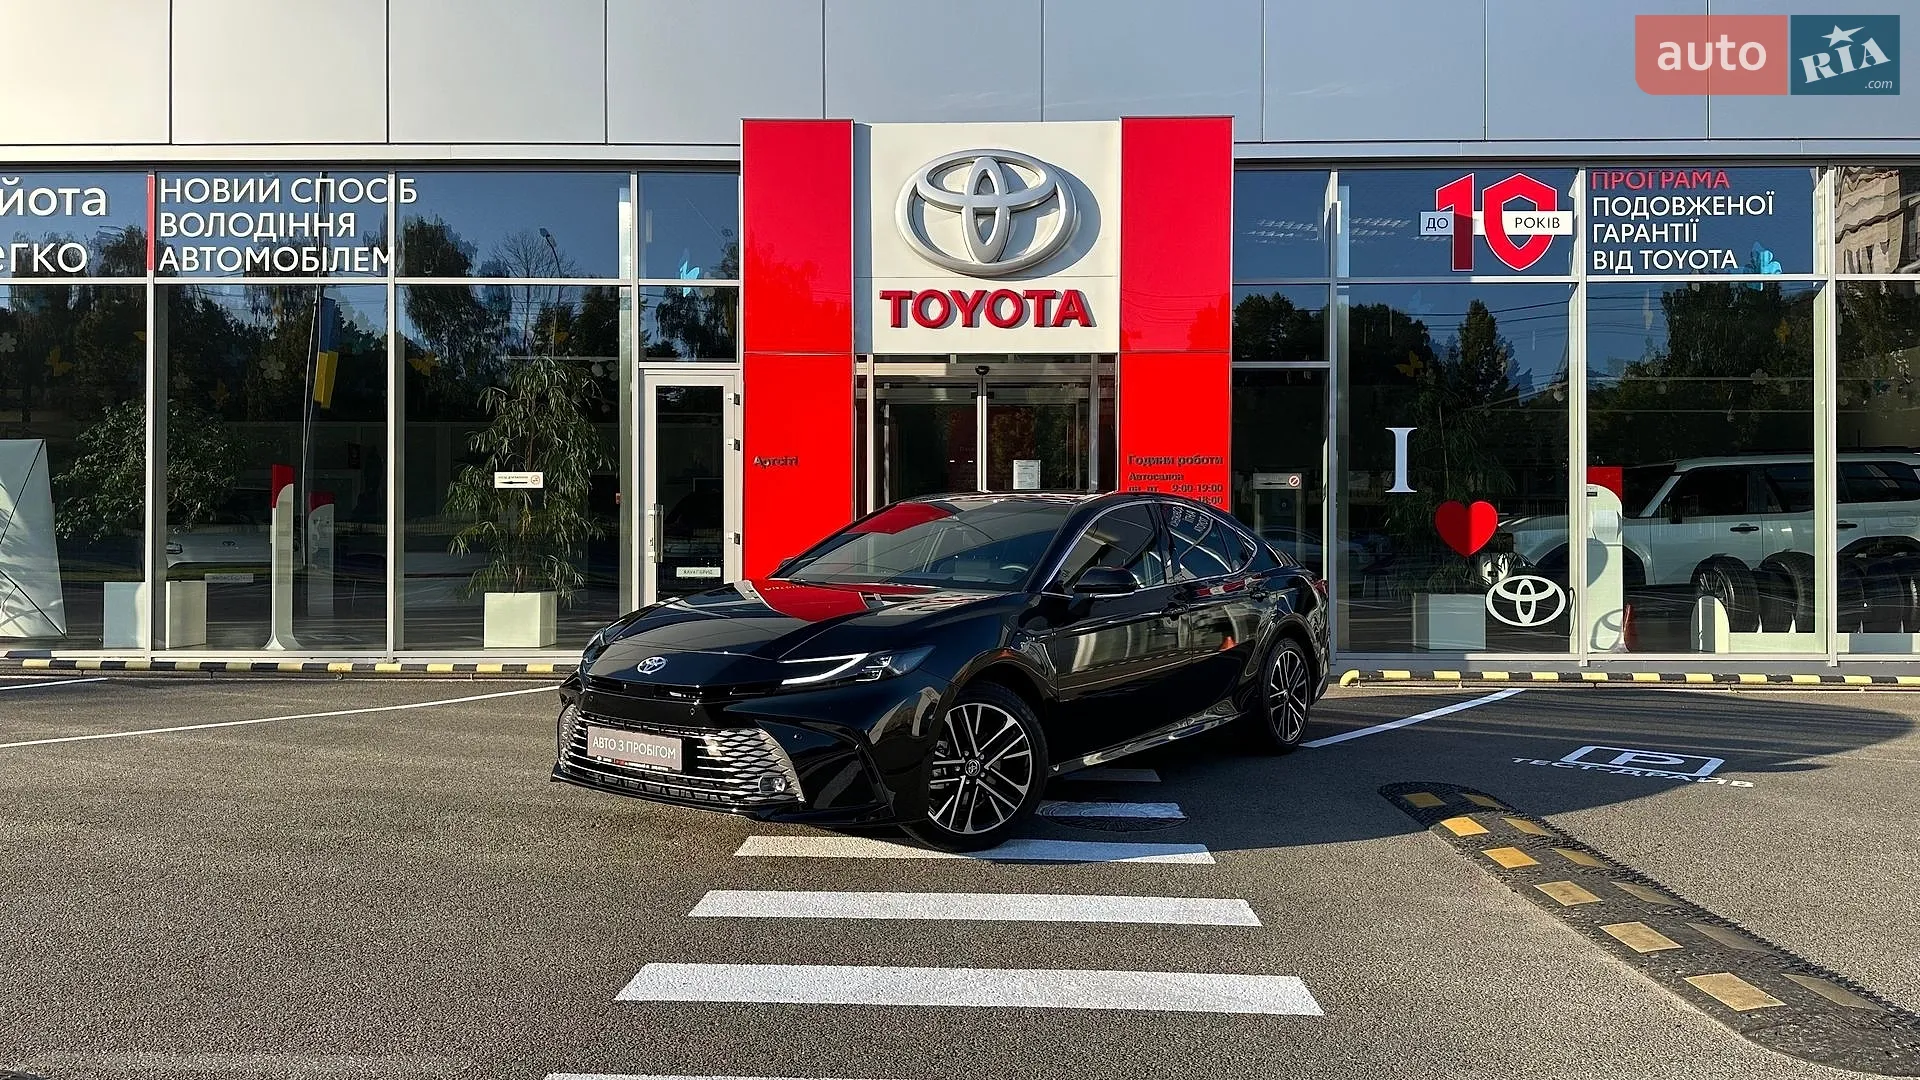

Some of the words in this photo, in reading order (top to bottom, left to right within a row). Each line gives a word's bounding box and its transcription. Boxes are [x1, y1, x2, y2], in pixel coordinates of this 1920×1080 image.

[1591, 169, 1730, 191] ПРОГРАМА
[0, 176, 106, 216] йота
[1593, 191, 1775, 220] ПОДОВЖЕНОЇ
[160, 212, 356, 243] ВОЛОДІННЯ
[1425, 216, 1449, 233] ДО
[1435, 173, 1558, 272] 10
[1514, 216, 1561, 229] РОКІВ
[1593, 219, 1699, 244] ГАРАНТІЇ
[0, 242, 88, 273] гко
[158, 246, 394, 272] АВТОМОБІЛЕМ
[1593, 250, 1634, 274] ВІД
[1641, 249, 1739, 270] TOYOTA
[879, 288, 1092, 330] TOYOTA
[1128, 455, 1173, 467] Години
[1178, 454, 1222, 466] роботи
[1384, 427, 1418, 493] I
[592, 735, 617, 751] АВТО
[627, 741, 676, 759] ПРОБІГОМ
[1608, 752, 1685, 766] P
[1511, 757, 1755, 788] ТЕСТ-ДРАЙВ
